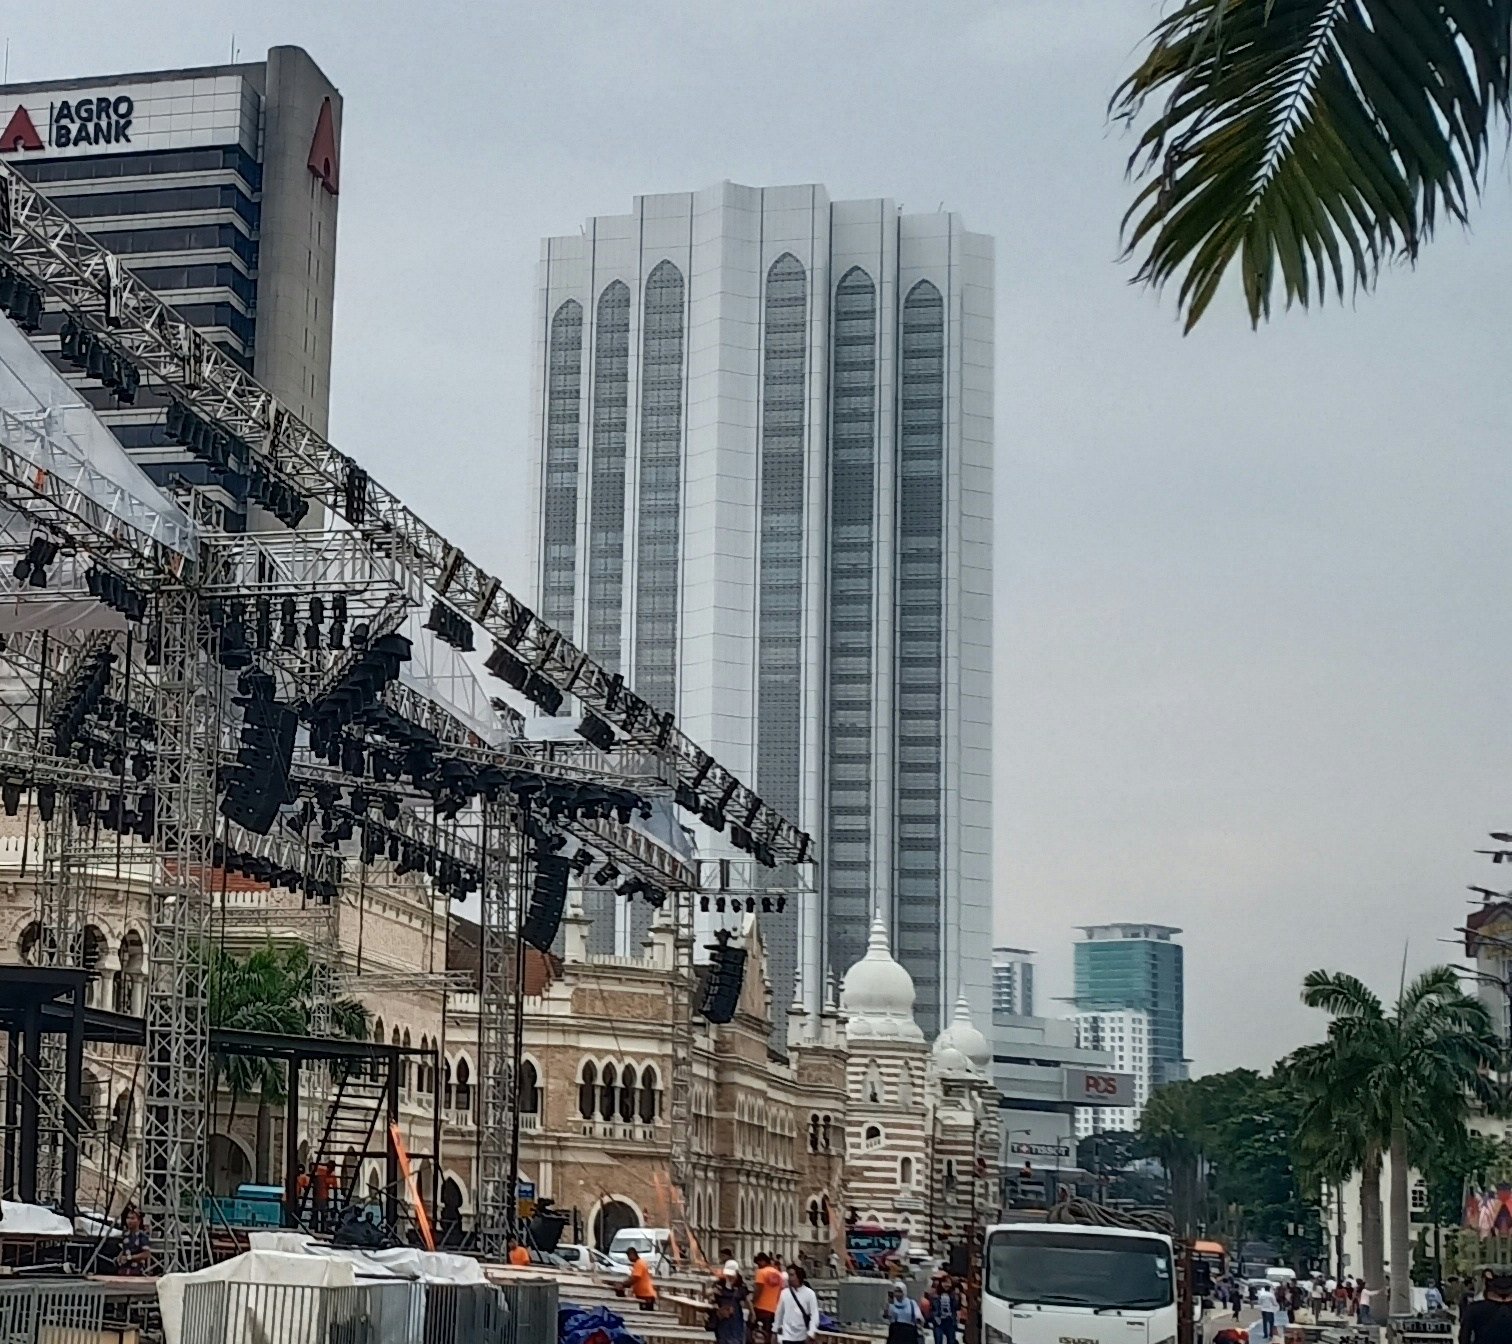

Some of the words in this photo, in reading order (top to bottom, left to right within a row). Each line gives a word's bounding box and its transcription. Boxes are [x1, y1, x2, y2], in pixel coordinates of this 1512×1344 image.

[54, 95, 134, 124] AGRO
[54, 119, 133, 148] BANK
[1086, 1075, 1117, 1094] POS
